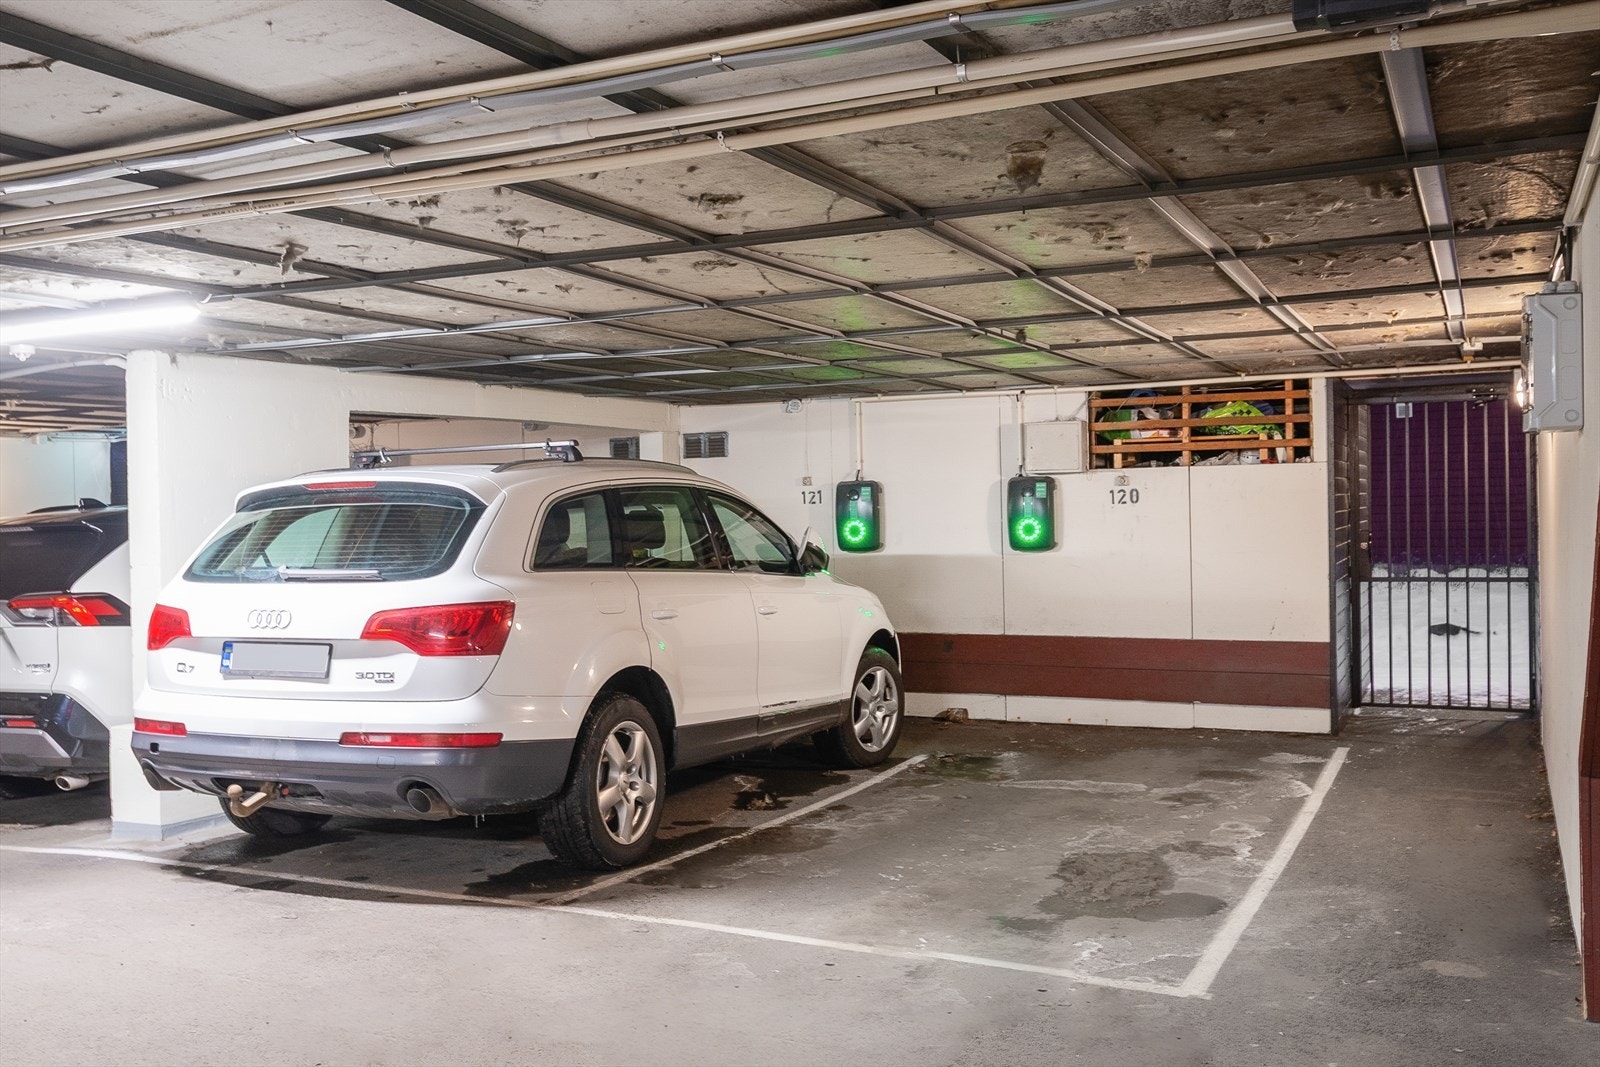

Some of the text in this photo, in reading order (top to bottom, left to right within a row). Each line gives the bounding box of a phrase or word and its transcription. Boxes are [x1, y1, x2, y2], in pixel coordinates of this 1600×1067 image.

[801, 490, 822, 504] 121
[1109, 488, 1140, 505] 120
[176, 662, 195, 673] Q7
